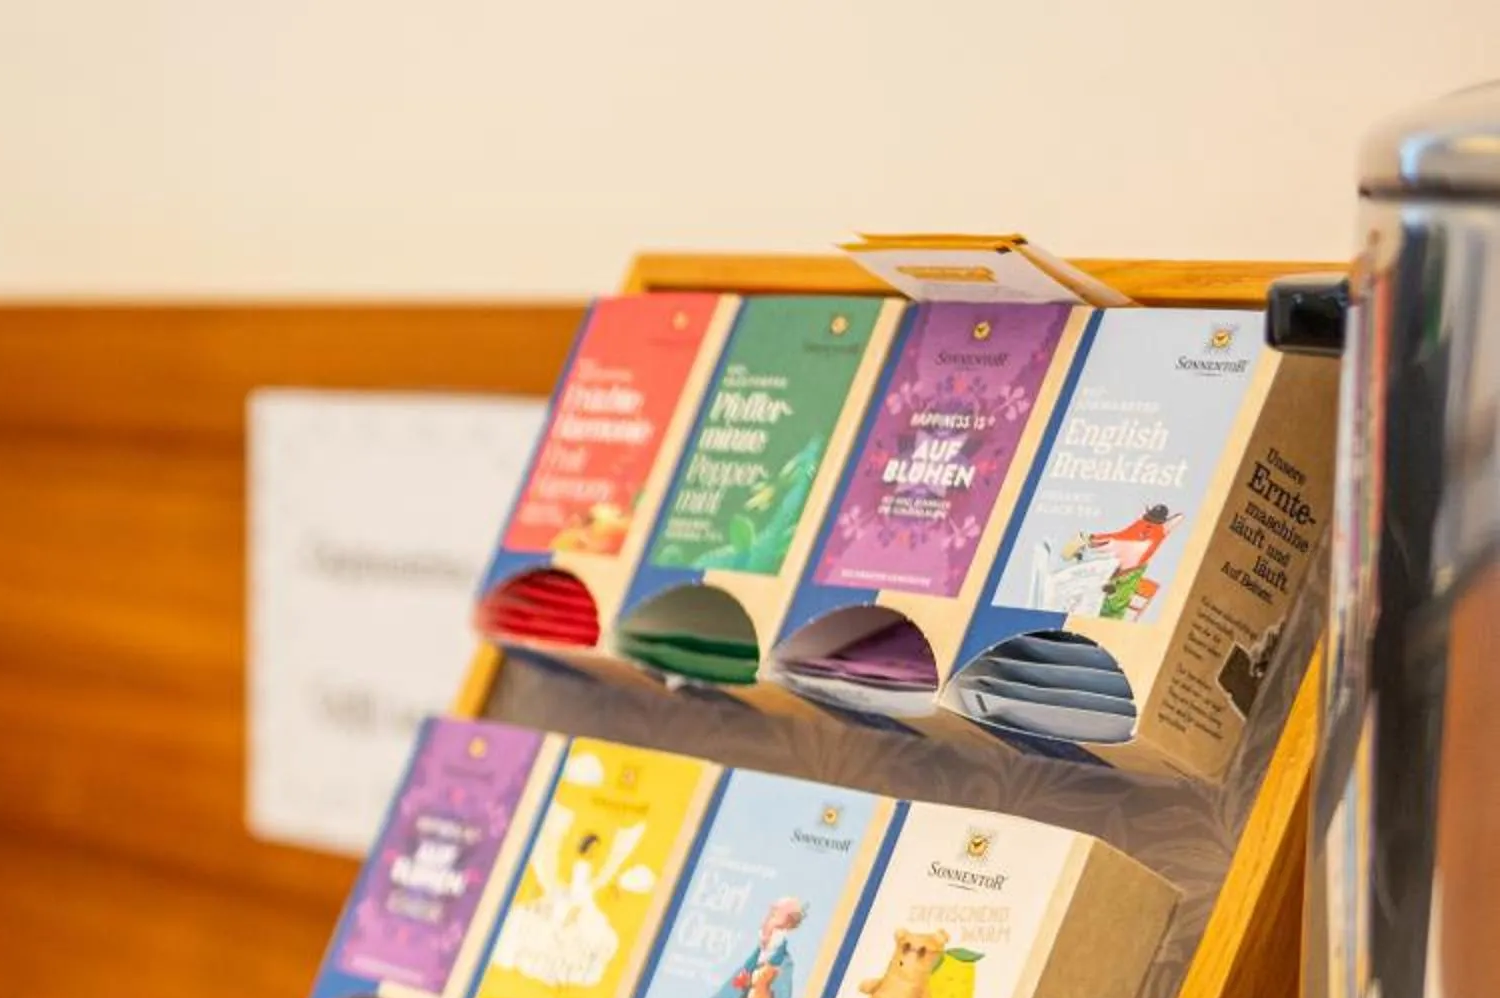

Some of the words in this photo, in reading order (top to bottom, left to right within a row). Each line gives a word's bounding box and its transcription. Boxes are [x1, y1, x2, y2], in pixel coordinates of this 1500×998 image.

[911, 438, 964, 462] AUF
[1064, 417, 1170, 454] English
[1051, 452, 1190, 488] Breakfast
[1247, 461, 1316, 525] Ernte-
[1229, 512, 1265, 548] läuft
[1245, 501, 1310, 553] maschine
[927, 861, 1008, 890] SONNENTOR
